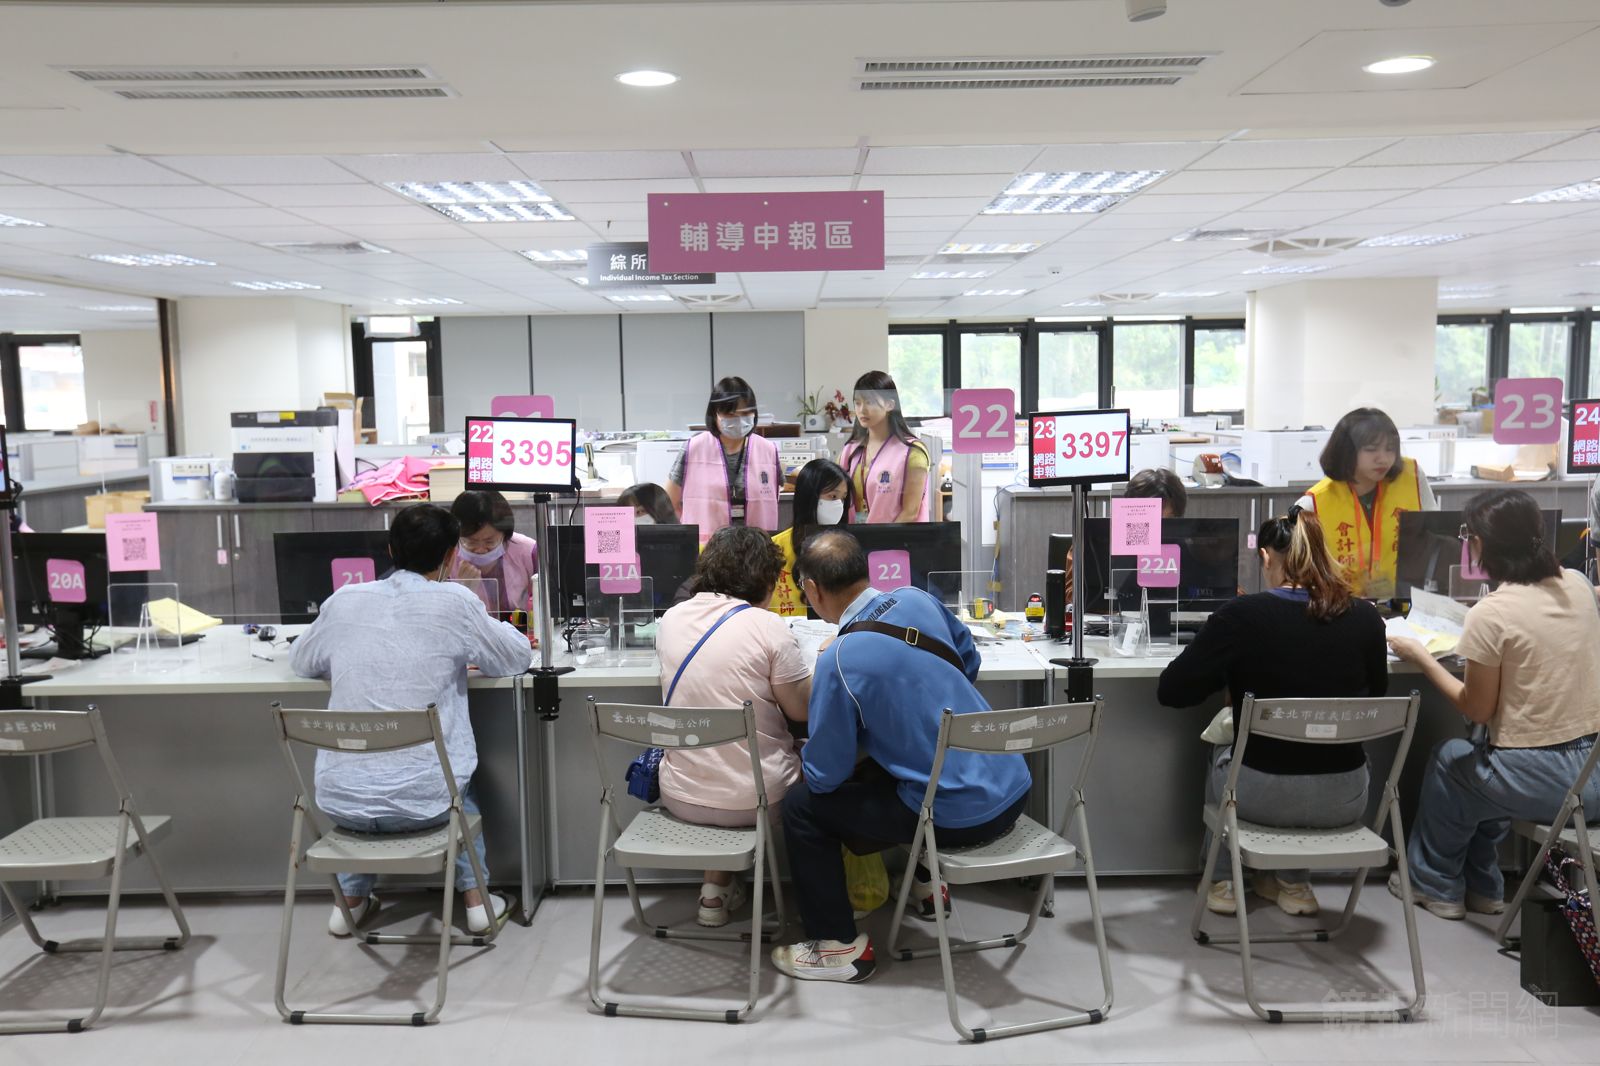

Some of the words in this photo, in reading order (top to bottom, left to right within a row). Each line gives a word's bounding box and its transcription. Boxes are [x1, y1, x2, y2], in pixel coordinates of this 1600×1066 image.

[680, 220, 853, 251] 輔導申報區
[610, 253, 647, 270] 綜所
[600, 273, 635, 281] Individual
[635, 273, 660, 281] Income
[661, 273, 673, 281] Tax
[673, 273, 699, 281] Section
[1500, 393, 1556, 429] 23
[1575, 406, 1600, 425] 24
[958, 404, 1009, 438] 22
[1034, 420, 1056, 439] 23
[470, 424, 493, 442] 22
[500, 439, 572, 467] 3395
[1062, 430, 1126, 460] 3397
[469, 456, 493, 471] 網路
[1034, 453, 1056, 466] 網路
[469, 470, 493, 482] 申報
[1034, 465, 1056, 478] 申報
[602, 564, 640, 581] 21A
[878, 563, 902, 580] 22
[1140, 557, 1178, 574] 22A
[50, 572, 84, 589] 20A
[342, 571, 364, 586] 21
